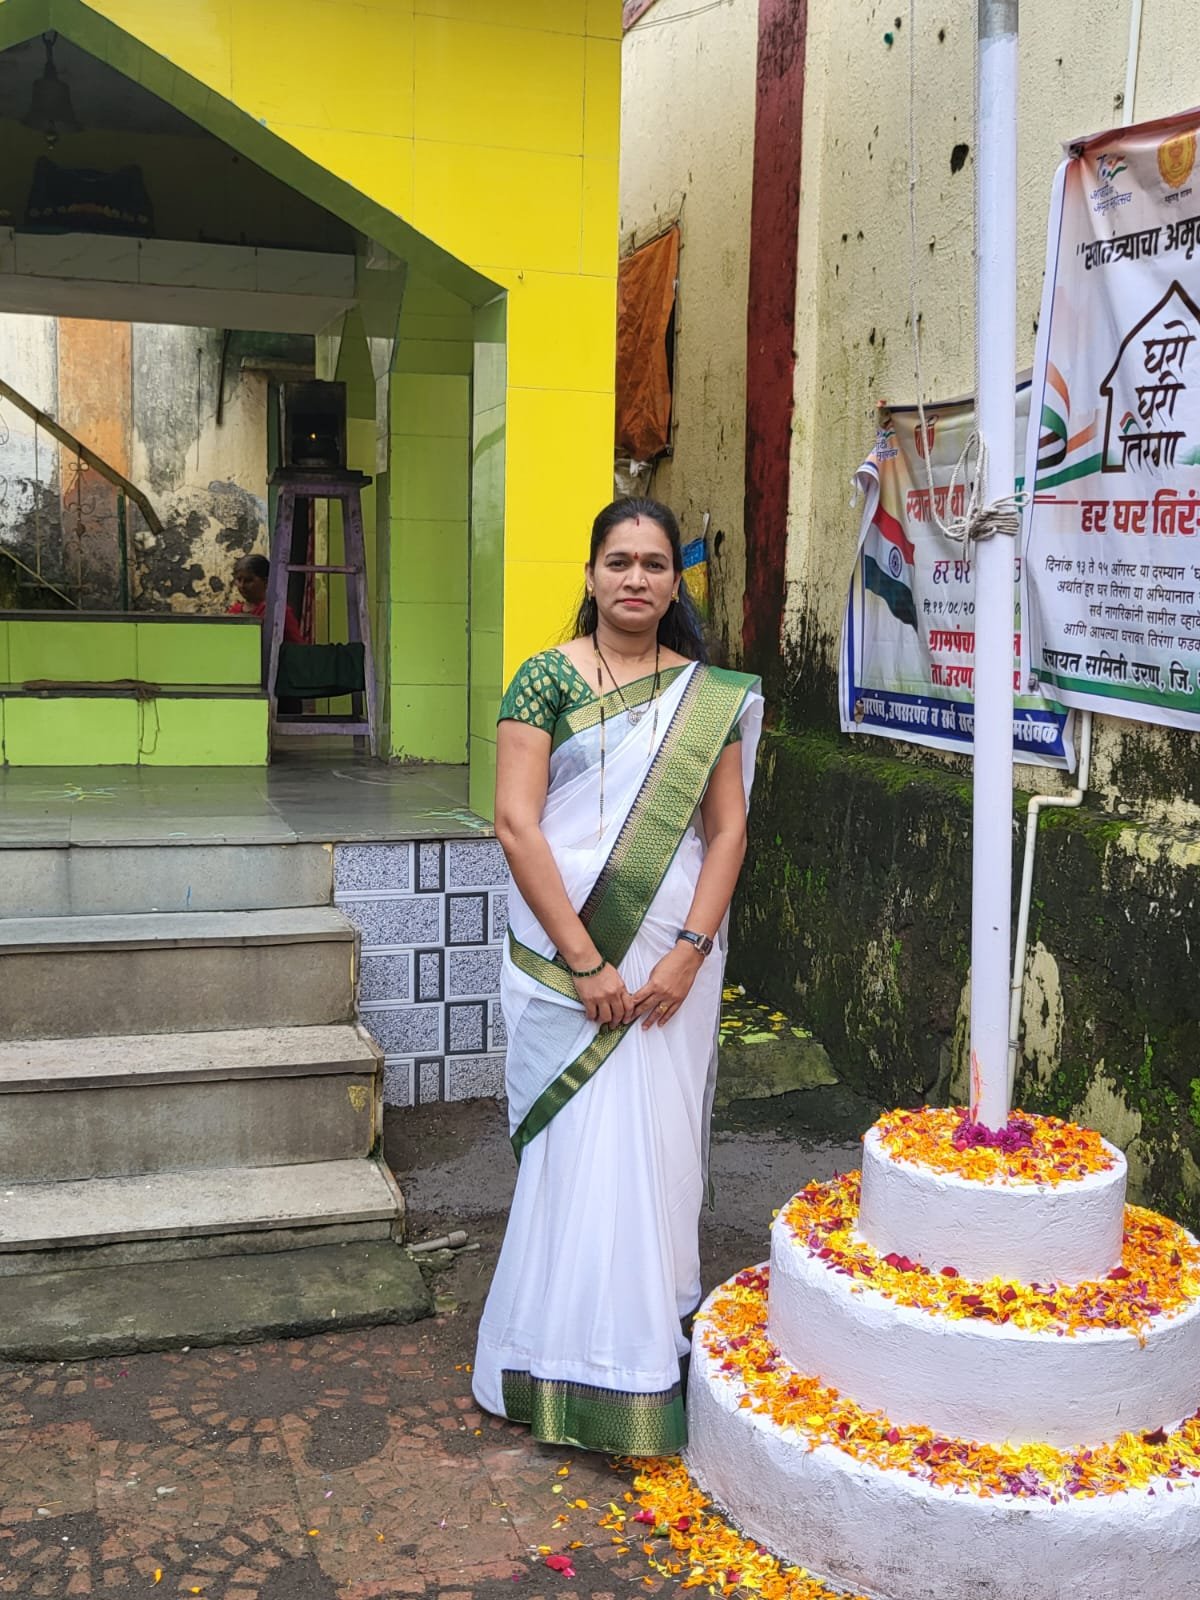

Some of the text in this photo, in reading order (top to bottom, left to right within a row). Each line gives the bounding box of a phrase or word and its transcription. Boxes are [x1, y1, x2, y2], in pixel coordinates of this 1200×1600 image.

[1081, 488, 1200, 535] हर घर तिरं
[933, 560, 971, 585] हर घर
[1045, 555, 1073, 573] दिनांक
[1076, 561, 1086, 576] १३
[1088, 557, 1095, 574] ते
[1111, 559, 1137, 577] ऑगस्ट
[1140, 565, 1150, 578] या
[1152, 566, 1186, 581] दरम्यान
[1057, 577, 1082, 594] अर्थात
[1097, 584, 1108, 597] घर
[1110, 580, 1131, 599] तिरंगा
[1134, 587, 1143, 600] या
[1146, 584, 1195, 605] अभियानात
[1089, 602, 1103, 617] सर्व
[1105, 603, 1143, 623] नागरिकांनी
[1146, 607, 1177, 626] सामील
[929, 624, 976, 654] ग्रामपंचा
[1064, 620, 1087, 637] आणि
[1090, 626, 1119, 641] आपल्या
[1121, 630, 1145, 645] घरावर
[1148, 628, 1174, 648] तिरंगा
[1042, 641, 1082, 673] पंचायत
[1085, 650, 1128, 681] समिती
[1131, 662, 1164, 690] उरण,
[1169, 659, 1193, 692] जि.
[931, 707, 939, 727] व
[941, 703, 957, 730] सर्व
